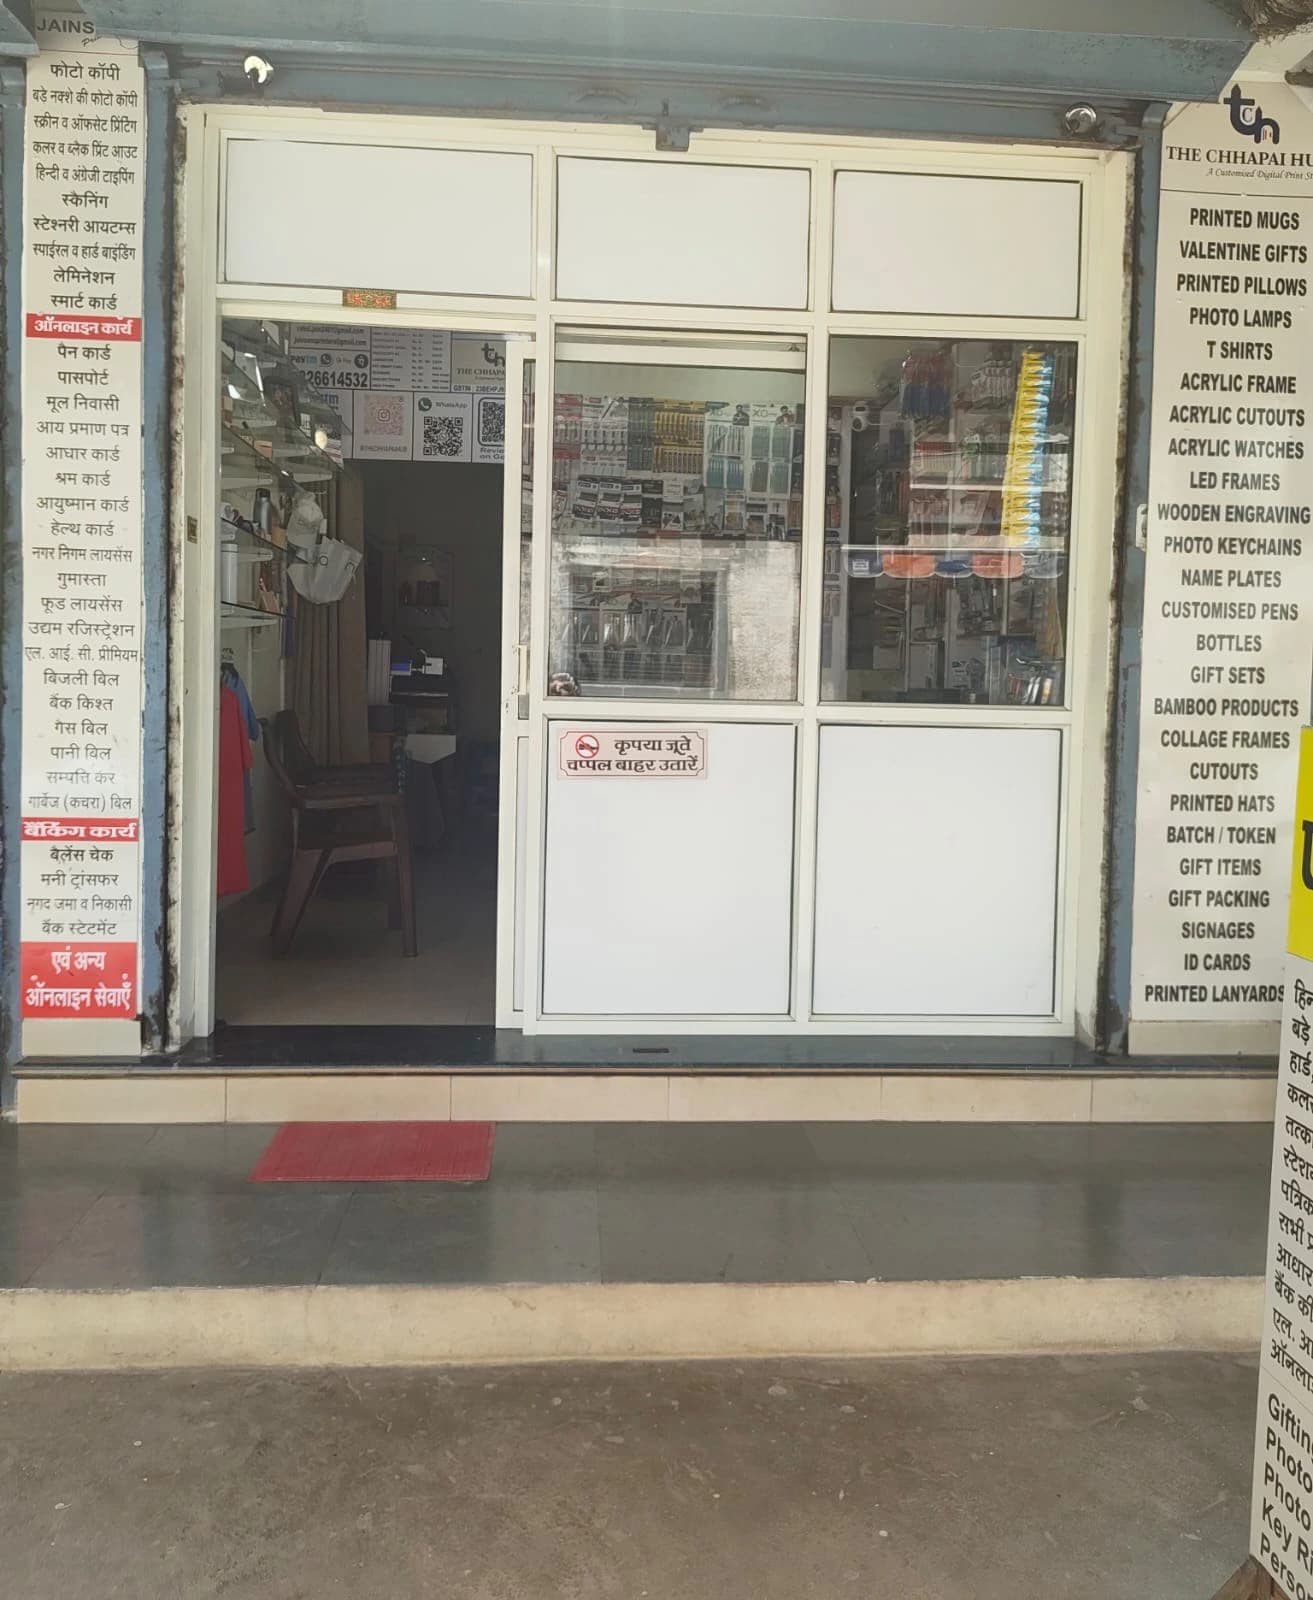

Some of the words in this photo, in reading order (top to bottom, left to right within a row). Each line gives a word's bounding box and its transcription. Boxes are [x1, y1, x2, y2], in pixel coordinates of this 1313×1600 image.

[36, 18, 95, 34] JAINS
[50, 61, 84, 79] फोटो
[88, 63, 120, 80] कॉपी
[34, 112, 59, 129] स्क्रीन
[62, 117, 69, 128] व
[71, 114, 108, 131] ऑफसेट
[32, 141, 56, 154] कलर
[58, 143, 65, 155] व
[92, 140, 109, 157] प्रिंट
[112, 145, 138, 158] आउट
[1166, 146, 1201, 161] THE
[1206, 150, 1288, 166] CHHAPAI
[36, 162, 60, 181] हिन्दी
[62, 168, 69, 180] व
[102, 167, 135, 186] टाइपिंग
[1257, 169, 1284, 181] Digital
[1285, 171, 1303, 180] Print
[33, 214, 80, 232] स्टेश्नरी
[1190, 208, 1252, 228] PRINTED
[1257, 211, 1299, 230] MUGS
[72, 245, 79, 257] व
[81, 242, 99, 259] हार्ड
[1180, 240, 1260, 261] VALENTINE
[1265, 244, 1307, 263] GIFTS
[53, 265, 116, 285] लेमिनेशन
[1177, 274, 1239, 293] PRINTED
[1245, 276, 1307, 296] PILLOWS
[51, 292, 84, 308] स्मार्ट
[88, 293, 117, 310] कार्ड
[35, 317, 99, 335] ऑनलाइन
[102, 319, 134, 336] कार्य
[1190, 307, 1239, 326] PHOTO
[1244, 309, 1292, 328] LAMPS
[57, 343, 78, 359] पैन
[82, 344, 112, 360] कार्ड
[1207, 341, 1216, 358] T
[1220, 341, 1272, 360] SHIRTS
[58, 369, 109, 385] पासपोर्ट
[1180, 373, 1242, 392] ACRYLIC
[1248, 375, 1296, 394] FRAME
[46, 396, 70, 413] मूल
[74, 393, 120, 411] निवासी
[1169, 405, 1232, 424] ACRYLIC
[1237, 407, 1305, 427] CUTOUTS
[37, 421, 65, 434] आय
[69, 423, 107, 436] प्रमाण
[110, 424, 130, 436] पत्र
[46, 447, 88, 460] आधार
[91, 445, 120, 461] कार्ड
[1168, 438, 1230, 457] ACRYLIC
[1235, 440, 1304, 459] WATCHES
[56, 473, 78, 485] श्रम
[81, 470, 111, 486] कार्ड
[1190, 471, 1217, 489] LED
[1222, 472, 1280, 491] FRAMES
[37, 497, 96, 514] आयुष्मान
[100, 496, 130, 512] कार्ड
[1158, 504, 1220, 522] WOODEN
[1225, 505, 1310, 524] ENGRAVING
[51, 518, 81, 536] हेल्थ
[85, 520, 115, 536] कार्ड
[1164, 536, 1213, 554] PHOTO
[1218, 537, 1301, 556] KEYCHAINS
[57, 573, 107, 589] गुमास्ता
[1182, 569, 1223, 586] NAME
[1228, 570, 1281, 588] PLATES
[41, 597, 66, 614] फूड
[1162, 601, 1256, 619] CUSTOMISED
[1261, 603, 1298, 621] PENS
[28, 622, 63, 634] उद्यम
[1197, 634, 1262, 652] BOTTLES
[43, 668, 89, 685] बिजली
[1191, 666, 1224, 683] GIFT
[1228, 667, 1265, 684] SETS
[1154, 698, 1217, 716] BAMBOO
[1221, 699, 1299, 717] PRODUCTS
[614, 739, 662, 756] कृपया
[665, 735, 692, 755] जूते
[1161, 730, 1228, 748] COLLAGE
[1232, 731, 1290, 749] FRAMES
[50, 743, 80, 759] पानी
[566, 759, 612, 771] चप्पल
[615, 760, 656, 773] बाहर
[658, 755, 699, 771] उतारें
[1190, 762, 1258, 780] CUTOUTS
[94, 771, 115, 784] कर
[1170, 794, 1233, 812] PRINTED
[1238, 795, 1275, 812] HATS
[90, 823, 137, 837] कार्य
[1167, 826, 1214, 843] BATCH
[1227, 827, 1276, 844] TOKEN
[89, 846, 114, 861] चेक
[1180, 858, 1213, 875] GIFT
[1218, 859, 1261, 876] ITEMS
[41, 869, 67, 886] मनी
[70, 869, 119, 889] ट्रांसफर
[27, 898, 51, 910] नगद
[54, 899, 77, 910] जमा
[80, 899, 88, 910] व
[91, 894, 132, 911] निकासी
[1169, 890, 1202, 907] GIFT
[1207, 890, 1269, 907] PACKING
[68, 919, 117, 935] स्टेटमेंट
[1182, 921, 1255, 939] SIGNAGES
[51, 946, 72, 973] एवं
[74, 952, 106, 970] अन्य
[1184, 953, 1198, 970] ID
[1203, 953, 1251, 971] CARDS
[26, 982, 92, 1010] ऑनलाइन
[1145, 985, 1207, 1002] PRINTED
[1292, 1014, 1311, 1046] बड़े
[1279, 1211, 1304, 1245] सभी
[1275, 1270, 1295, 1304] बैंक
[1268, 1393, 1313, 1464] Giftin
[1266, 1426, 1313, 1494] Photo
[1264, 1461, 1311, 1531] Photo
[1262, 1496, 1293, 1553] Key
